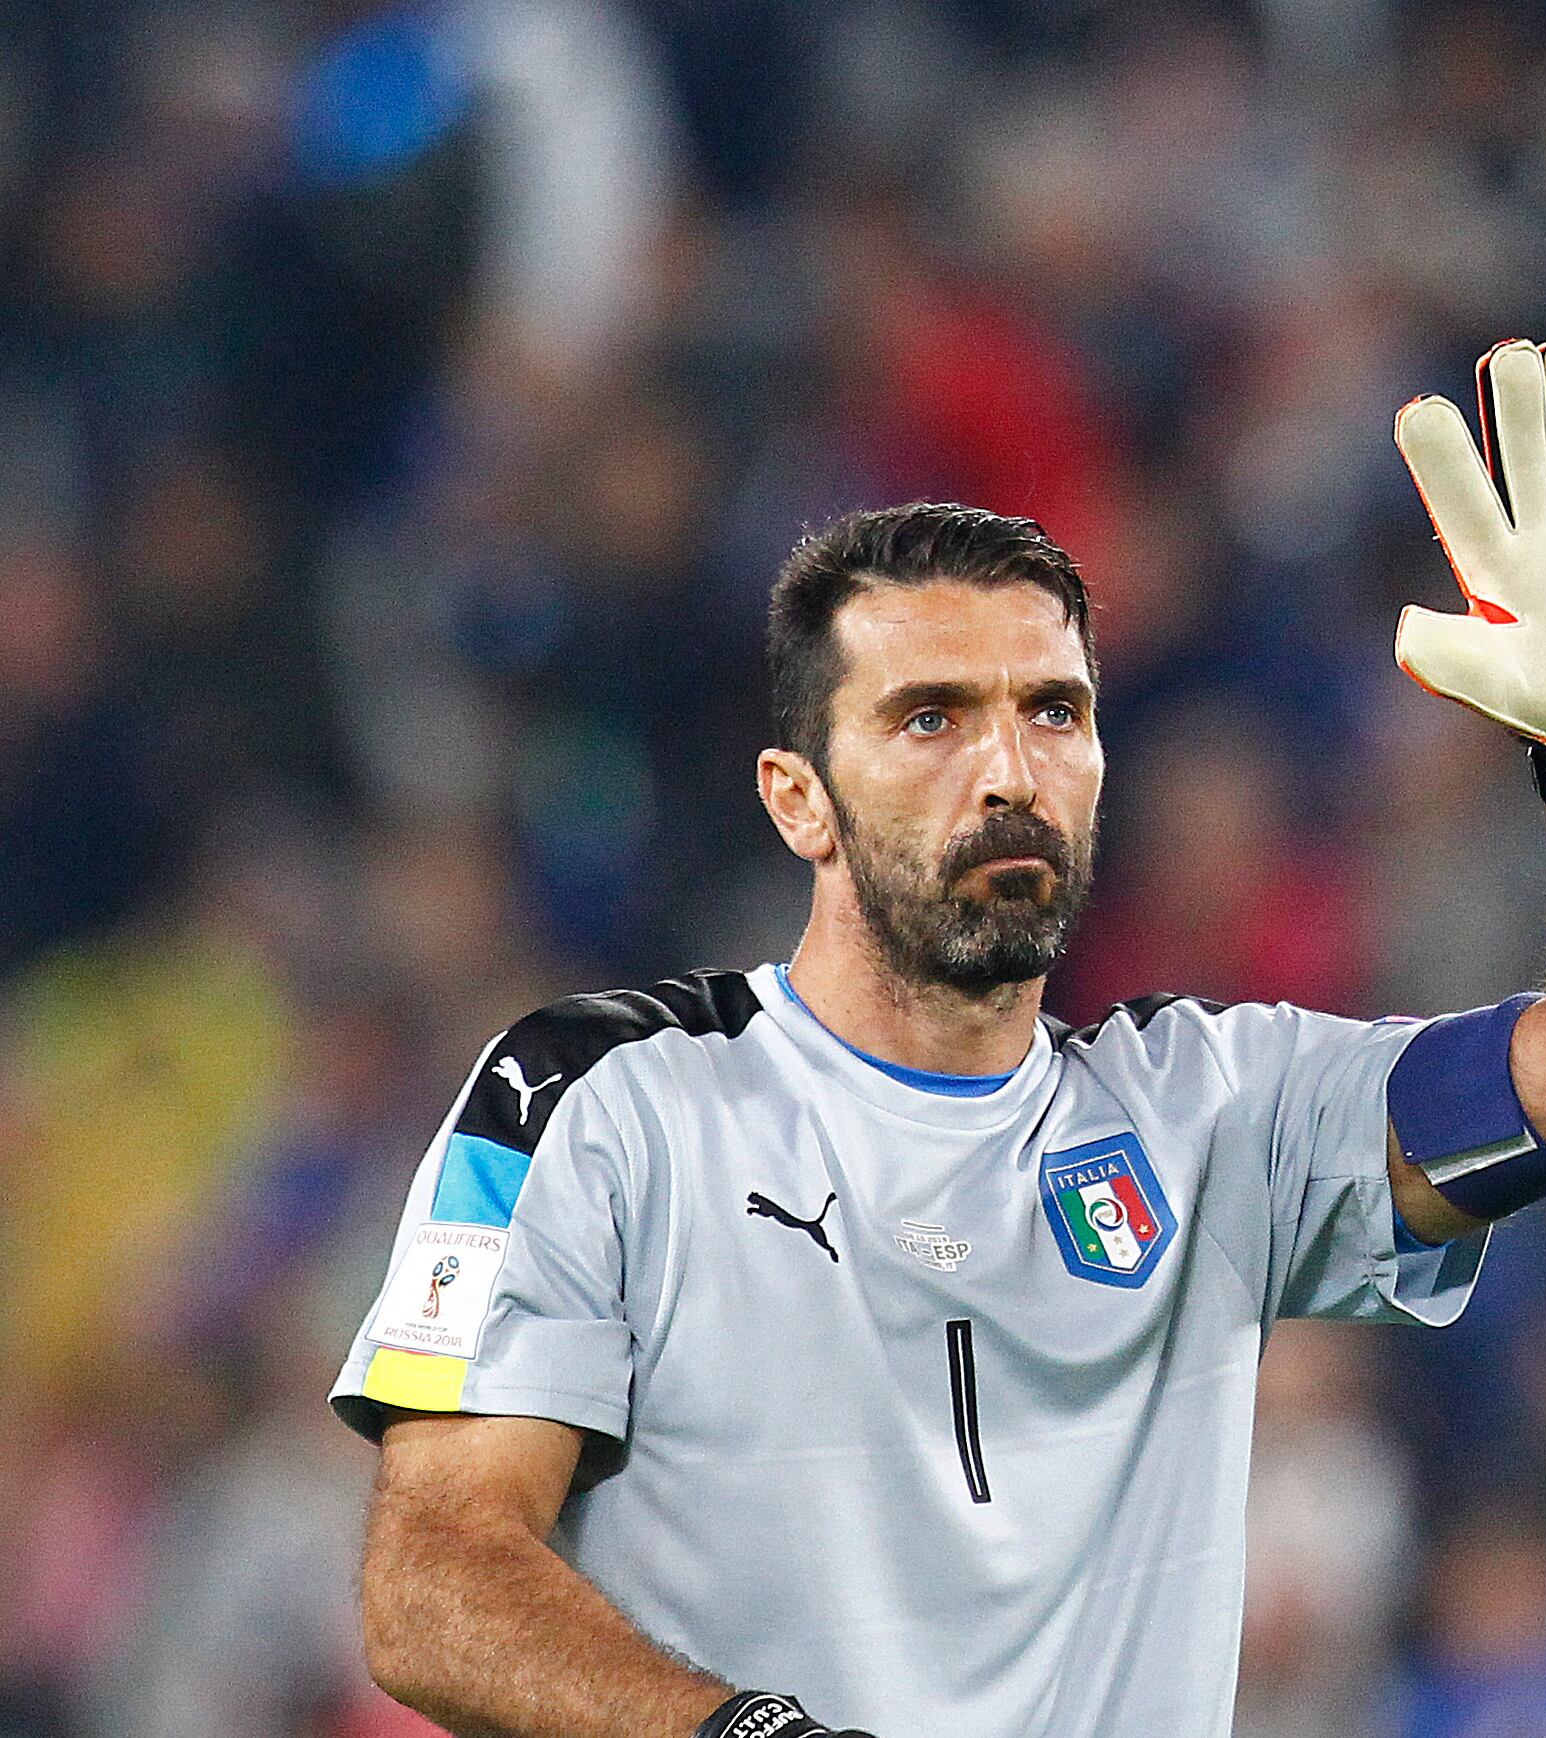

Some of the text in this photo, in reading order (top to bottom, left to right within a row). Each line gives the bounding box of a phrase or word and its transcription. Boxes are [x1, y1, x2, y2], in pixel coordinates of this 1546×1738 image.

[1057, 1162, 1119, 1190] ITALIA
[416, 1229, 501, 1252] QUALIFIERS
[933, 1243, 969, 1260] ESP
[384, 1326, 432, 1343] RUSSIA
[432, 1334, 463, 1348] 2018
[946, 1320, 991, 1504] 1
